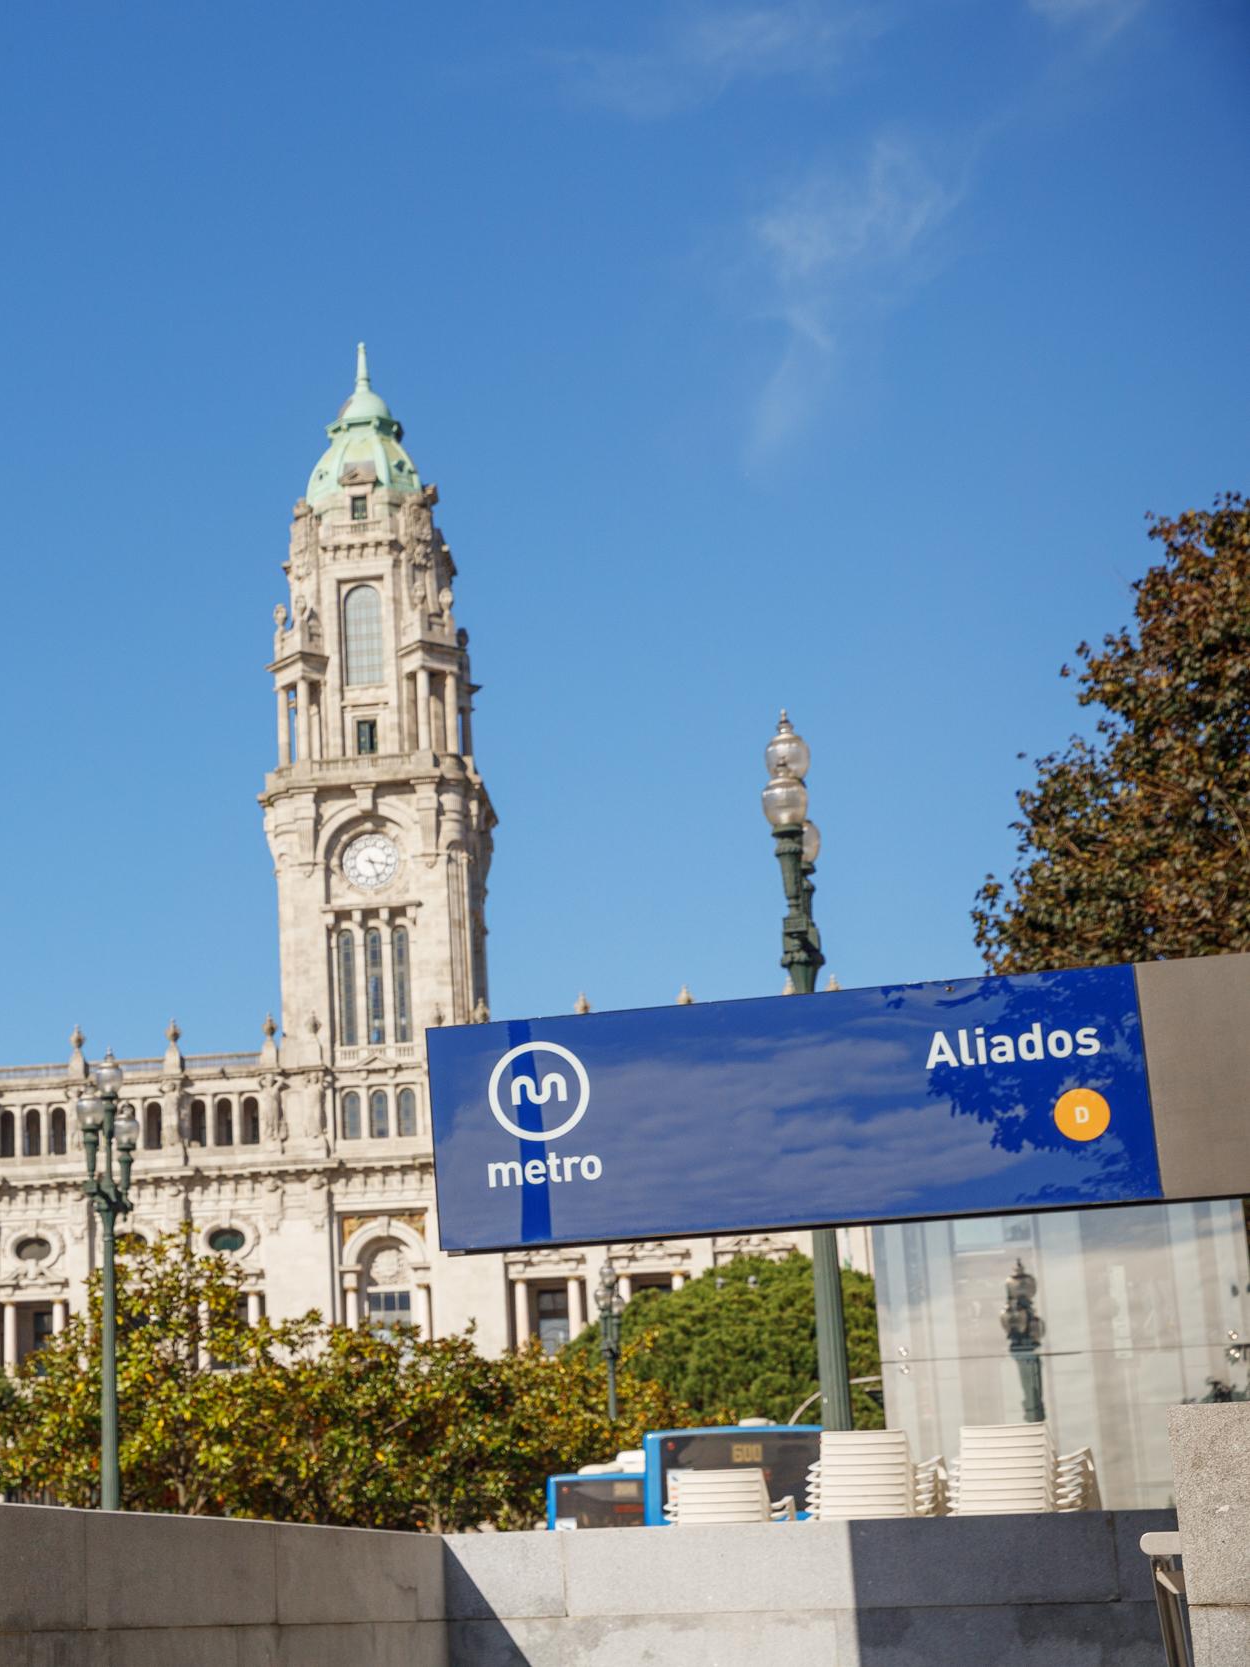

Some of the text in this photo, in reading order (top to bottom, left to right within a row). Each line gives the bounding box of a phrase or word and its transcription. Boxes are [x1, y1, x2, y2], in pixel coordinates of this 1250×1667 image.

[926, 1022, 1101, 1070] Aliados
[1074, 1107, 1090, 1124] D
[487, 1152, 603, 1188] metro
